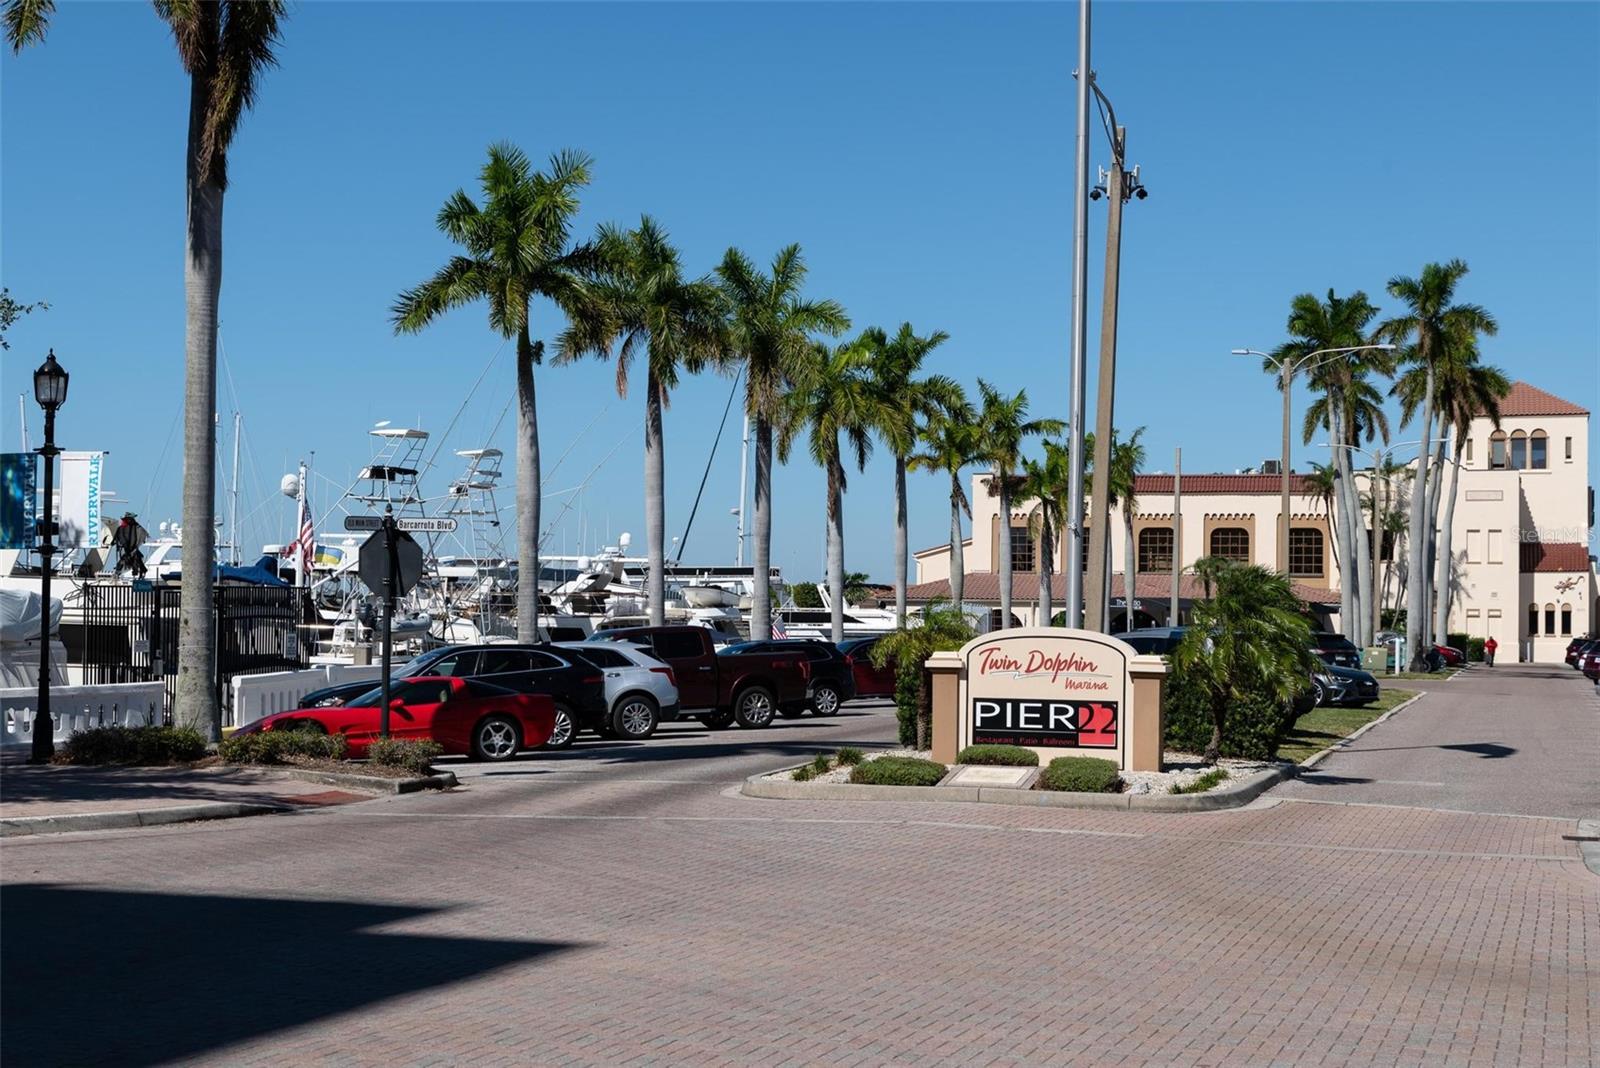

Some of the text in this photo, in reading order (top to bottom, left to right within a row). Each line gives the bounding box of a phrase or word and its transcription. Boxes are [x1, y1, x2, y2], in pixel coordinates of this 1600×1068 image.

[24, 454, 36, 548] RIVERWALK
[88, 454, 100, 546] RIVERWALK
[399, 520, 434, 530] Barcarrota
[979, 647, 1098, 683] Twin Dolphin
